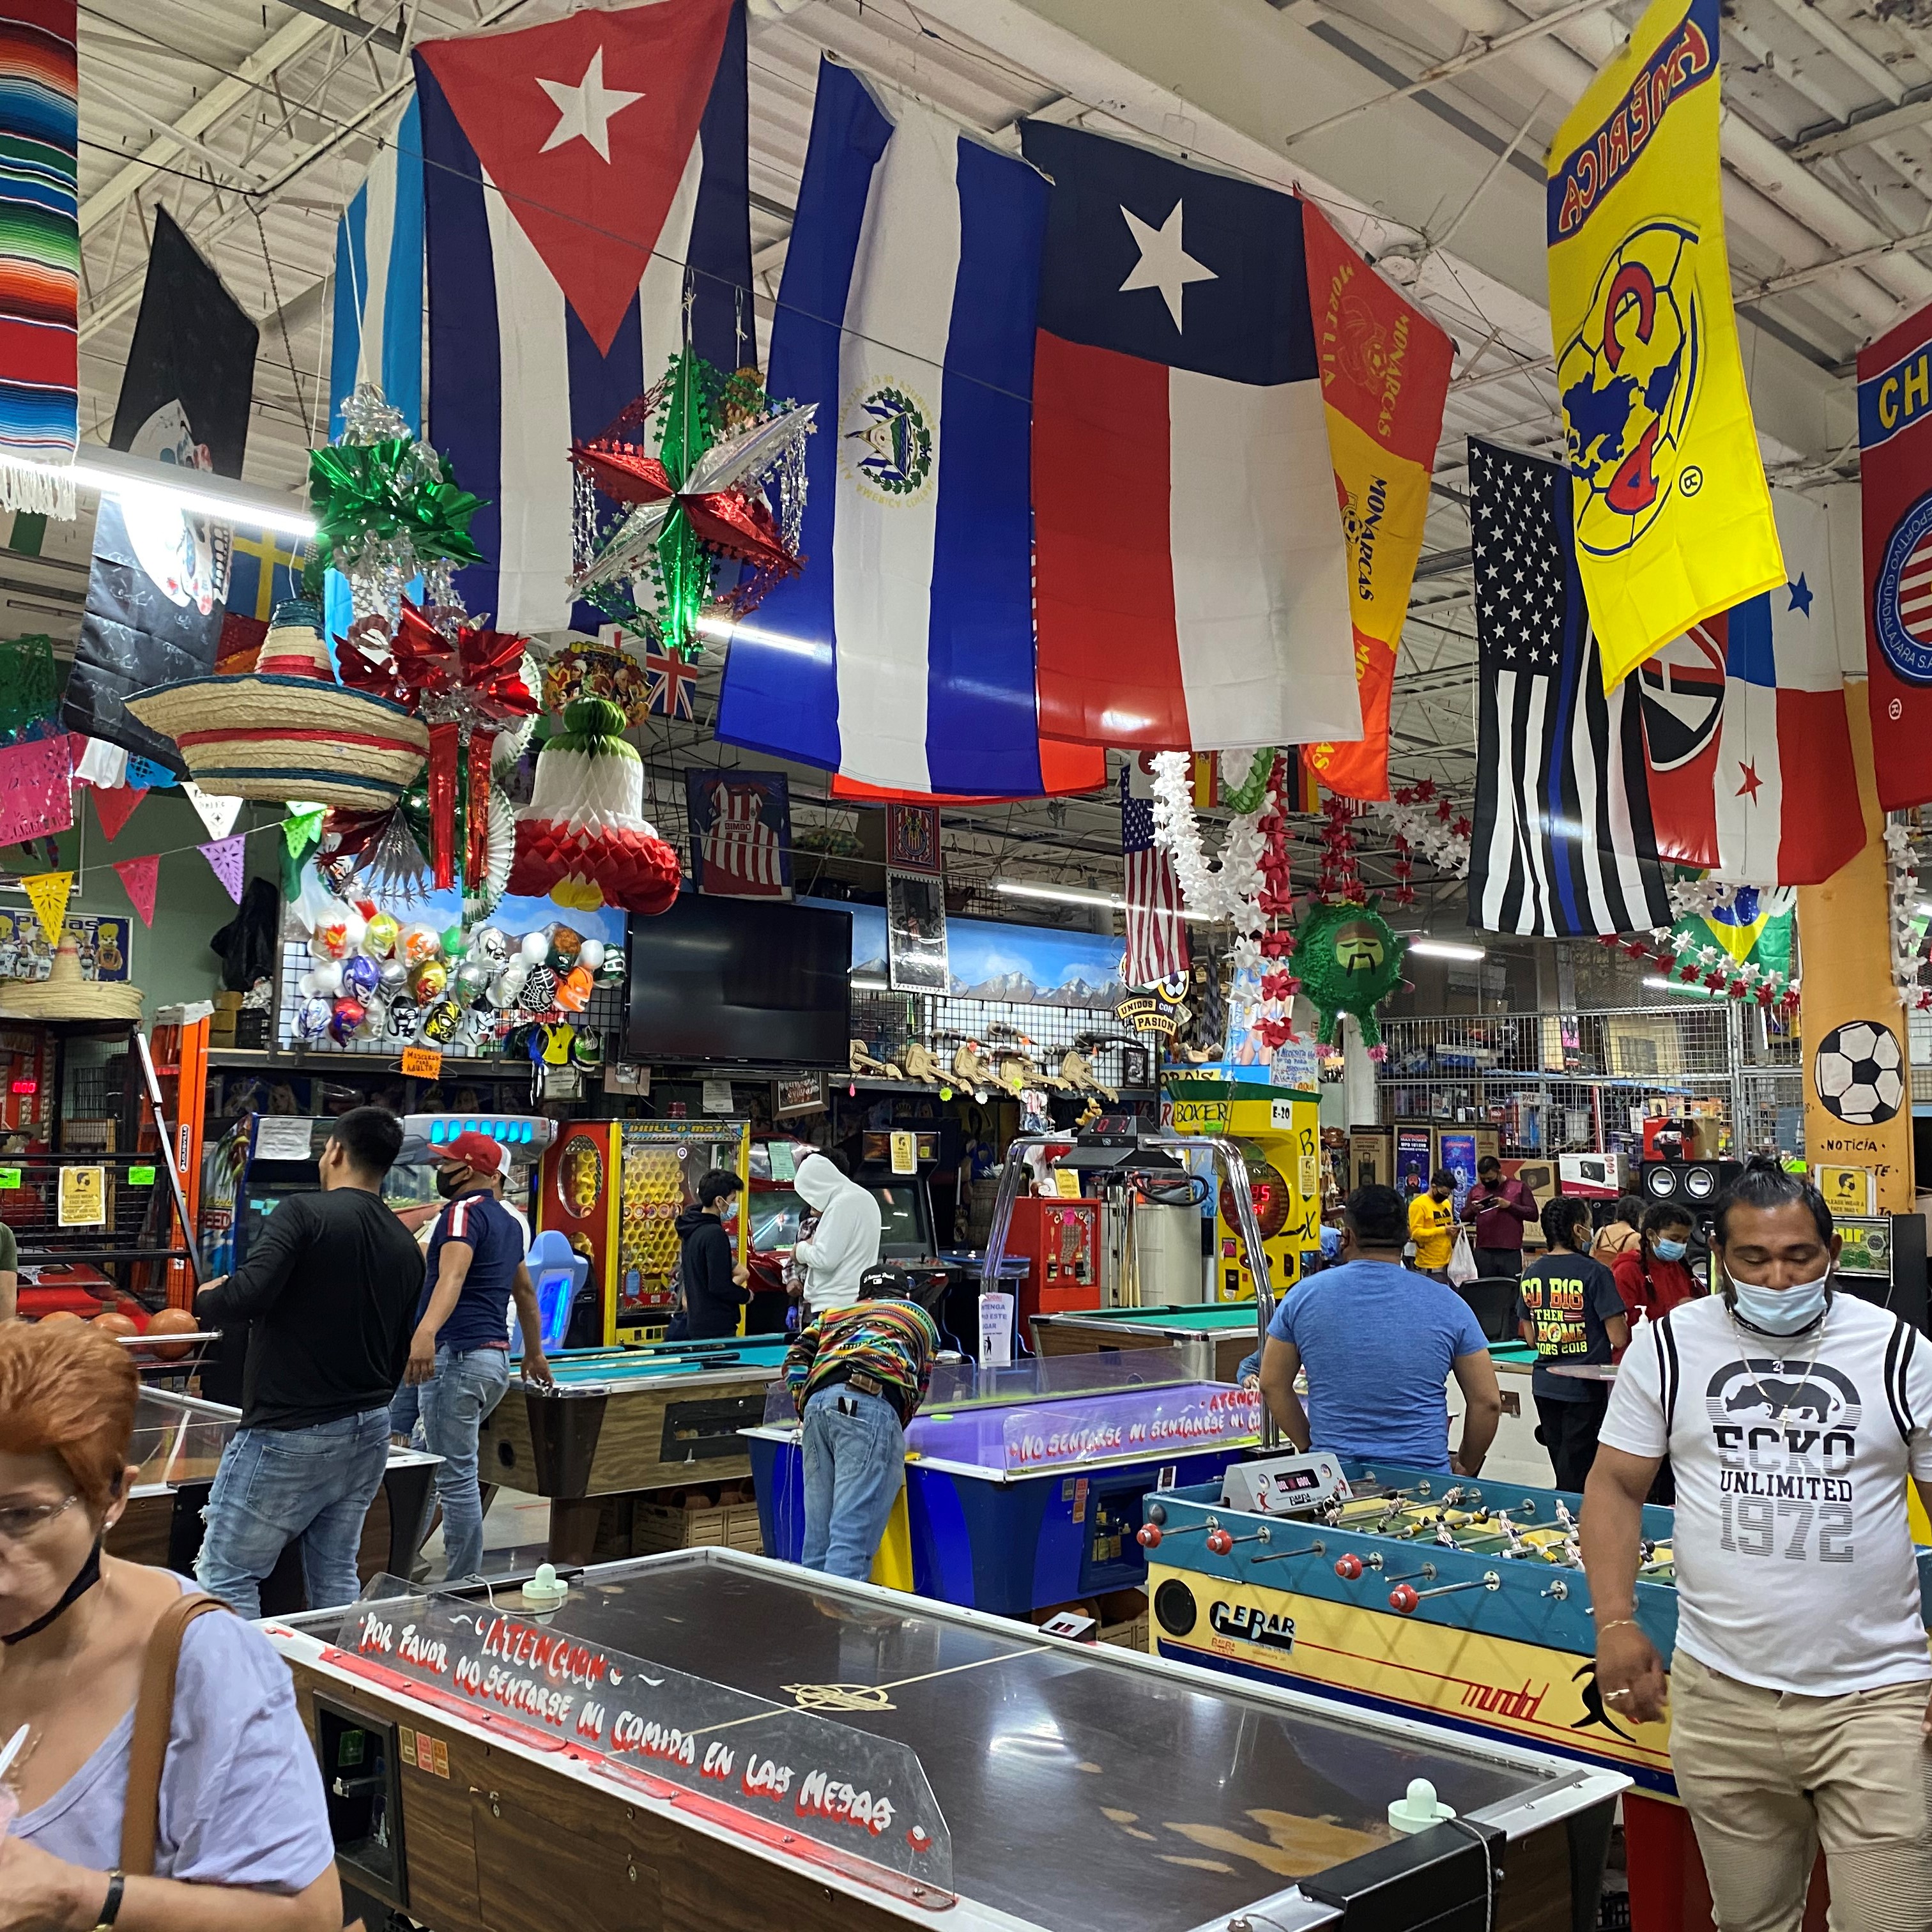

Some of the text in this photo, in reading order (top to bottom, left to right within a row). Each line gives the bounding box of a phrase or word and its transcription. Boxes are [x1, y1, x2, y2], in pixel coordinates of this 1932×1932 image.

[1378, 311, 1411, 437] MONARCAS
[1359, 474, 1388, 601] MONARCAS
[724, 822, 751, 831] BIMBO
[1121, 1000, 1174, 1015] UNIDOS CON
[1137, 1017, 1175, 1032] PASION
[1176, 1102, 1229, 1123] BOXER
[1273, 1105, 1290, 1119] E-20
[1535, 1309, 1564, 1321] THEN
[1537, 1321, 1586, 1343] HOME
[1561, 1342, 1588, 1353] 2018
[1020, 1434, 1044, 1462] NO
[1713, 1425, 1855, 1478] ECKO
[1721, 1471, 1852, 1502] UNLIMITED
[1720, 1494, 1854, 1563] 1972
[360, 1612, 896, 1836] POR FAVOR NO SENTARSE NI COMIDA EN LAS MESAS
